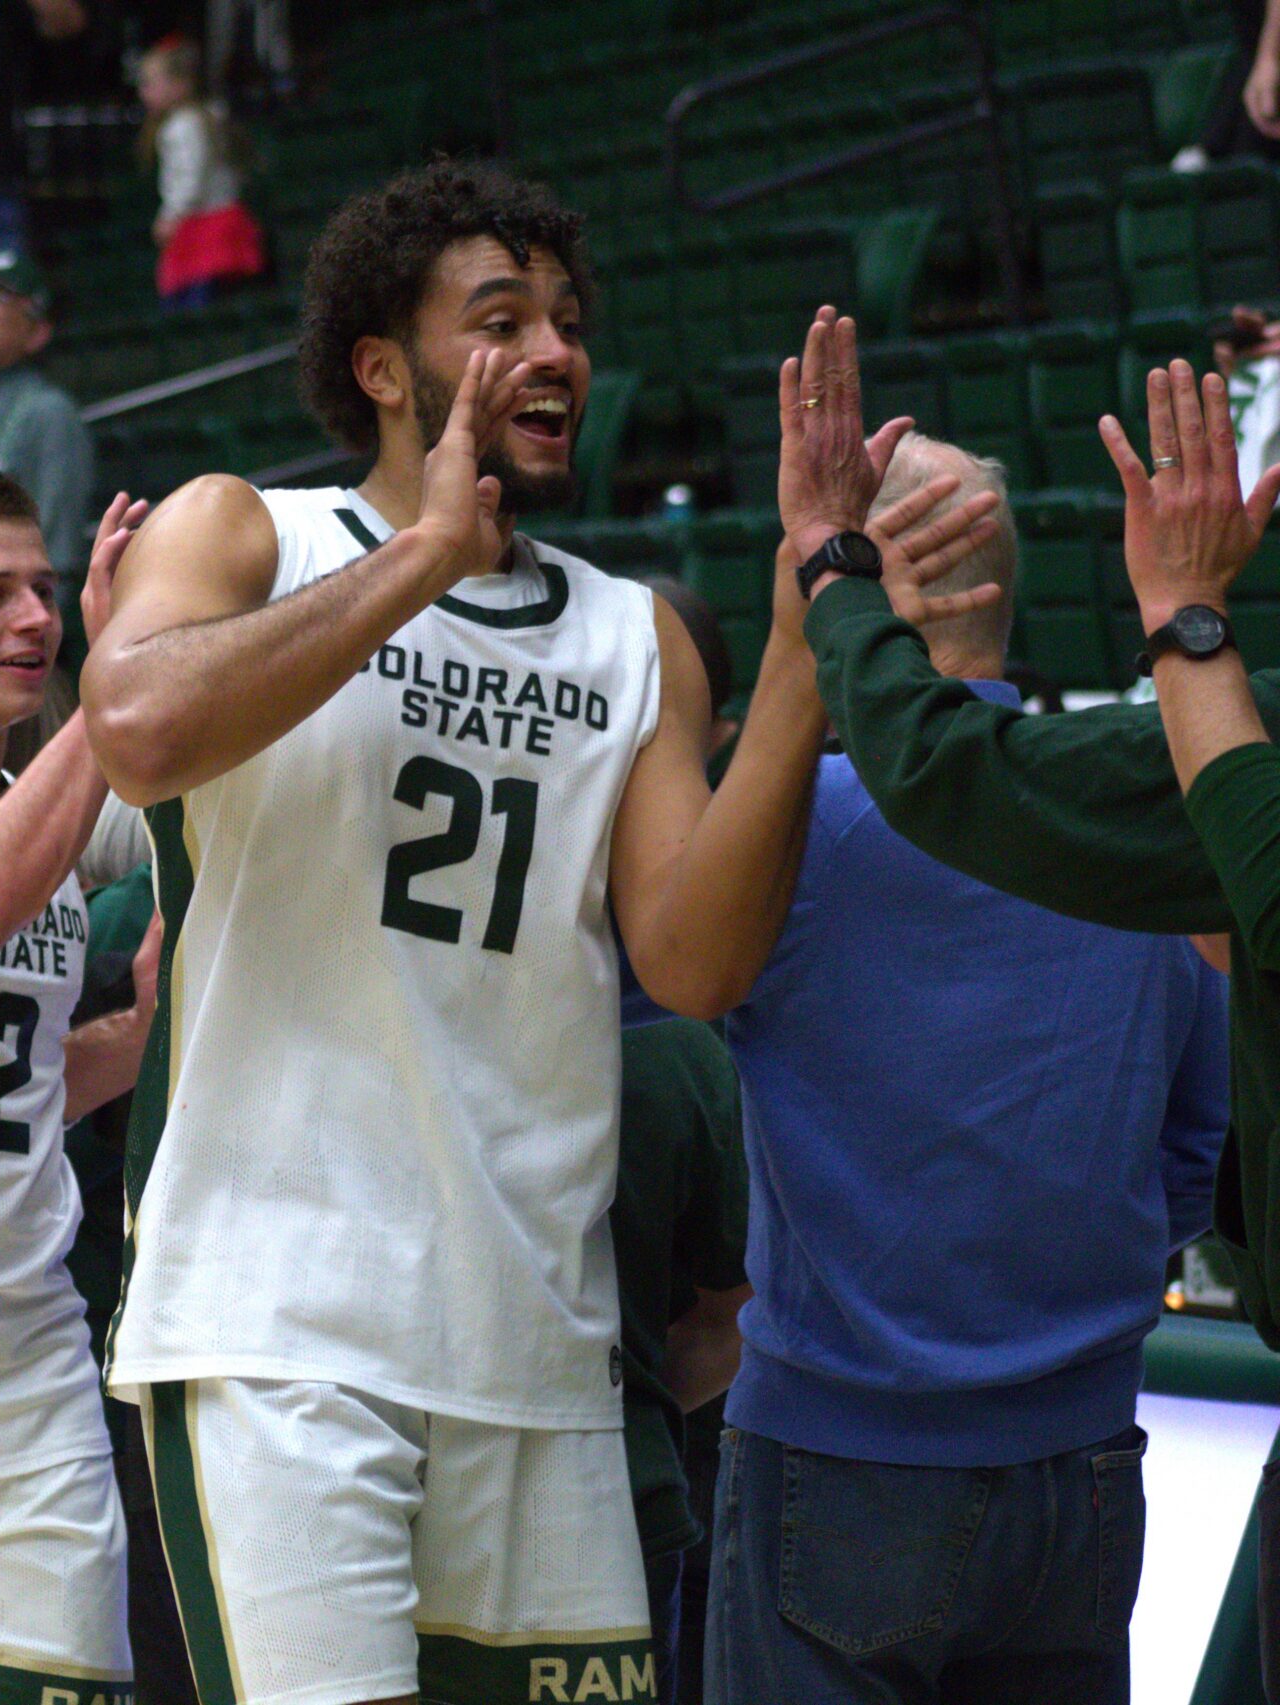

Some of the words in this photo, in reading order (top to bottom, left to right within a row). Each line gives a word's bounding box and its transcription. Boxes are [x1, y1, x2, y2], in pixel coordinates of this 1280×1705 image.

[358, 644, 609, 732] OLORADO
[400, 688, 555, 756] STATE
[381, 755, 539, 955] 21
[529, 1652, 658, 1703] RAM
